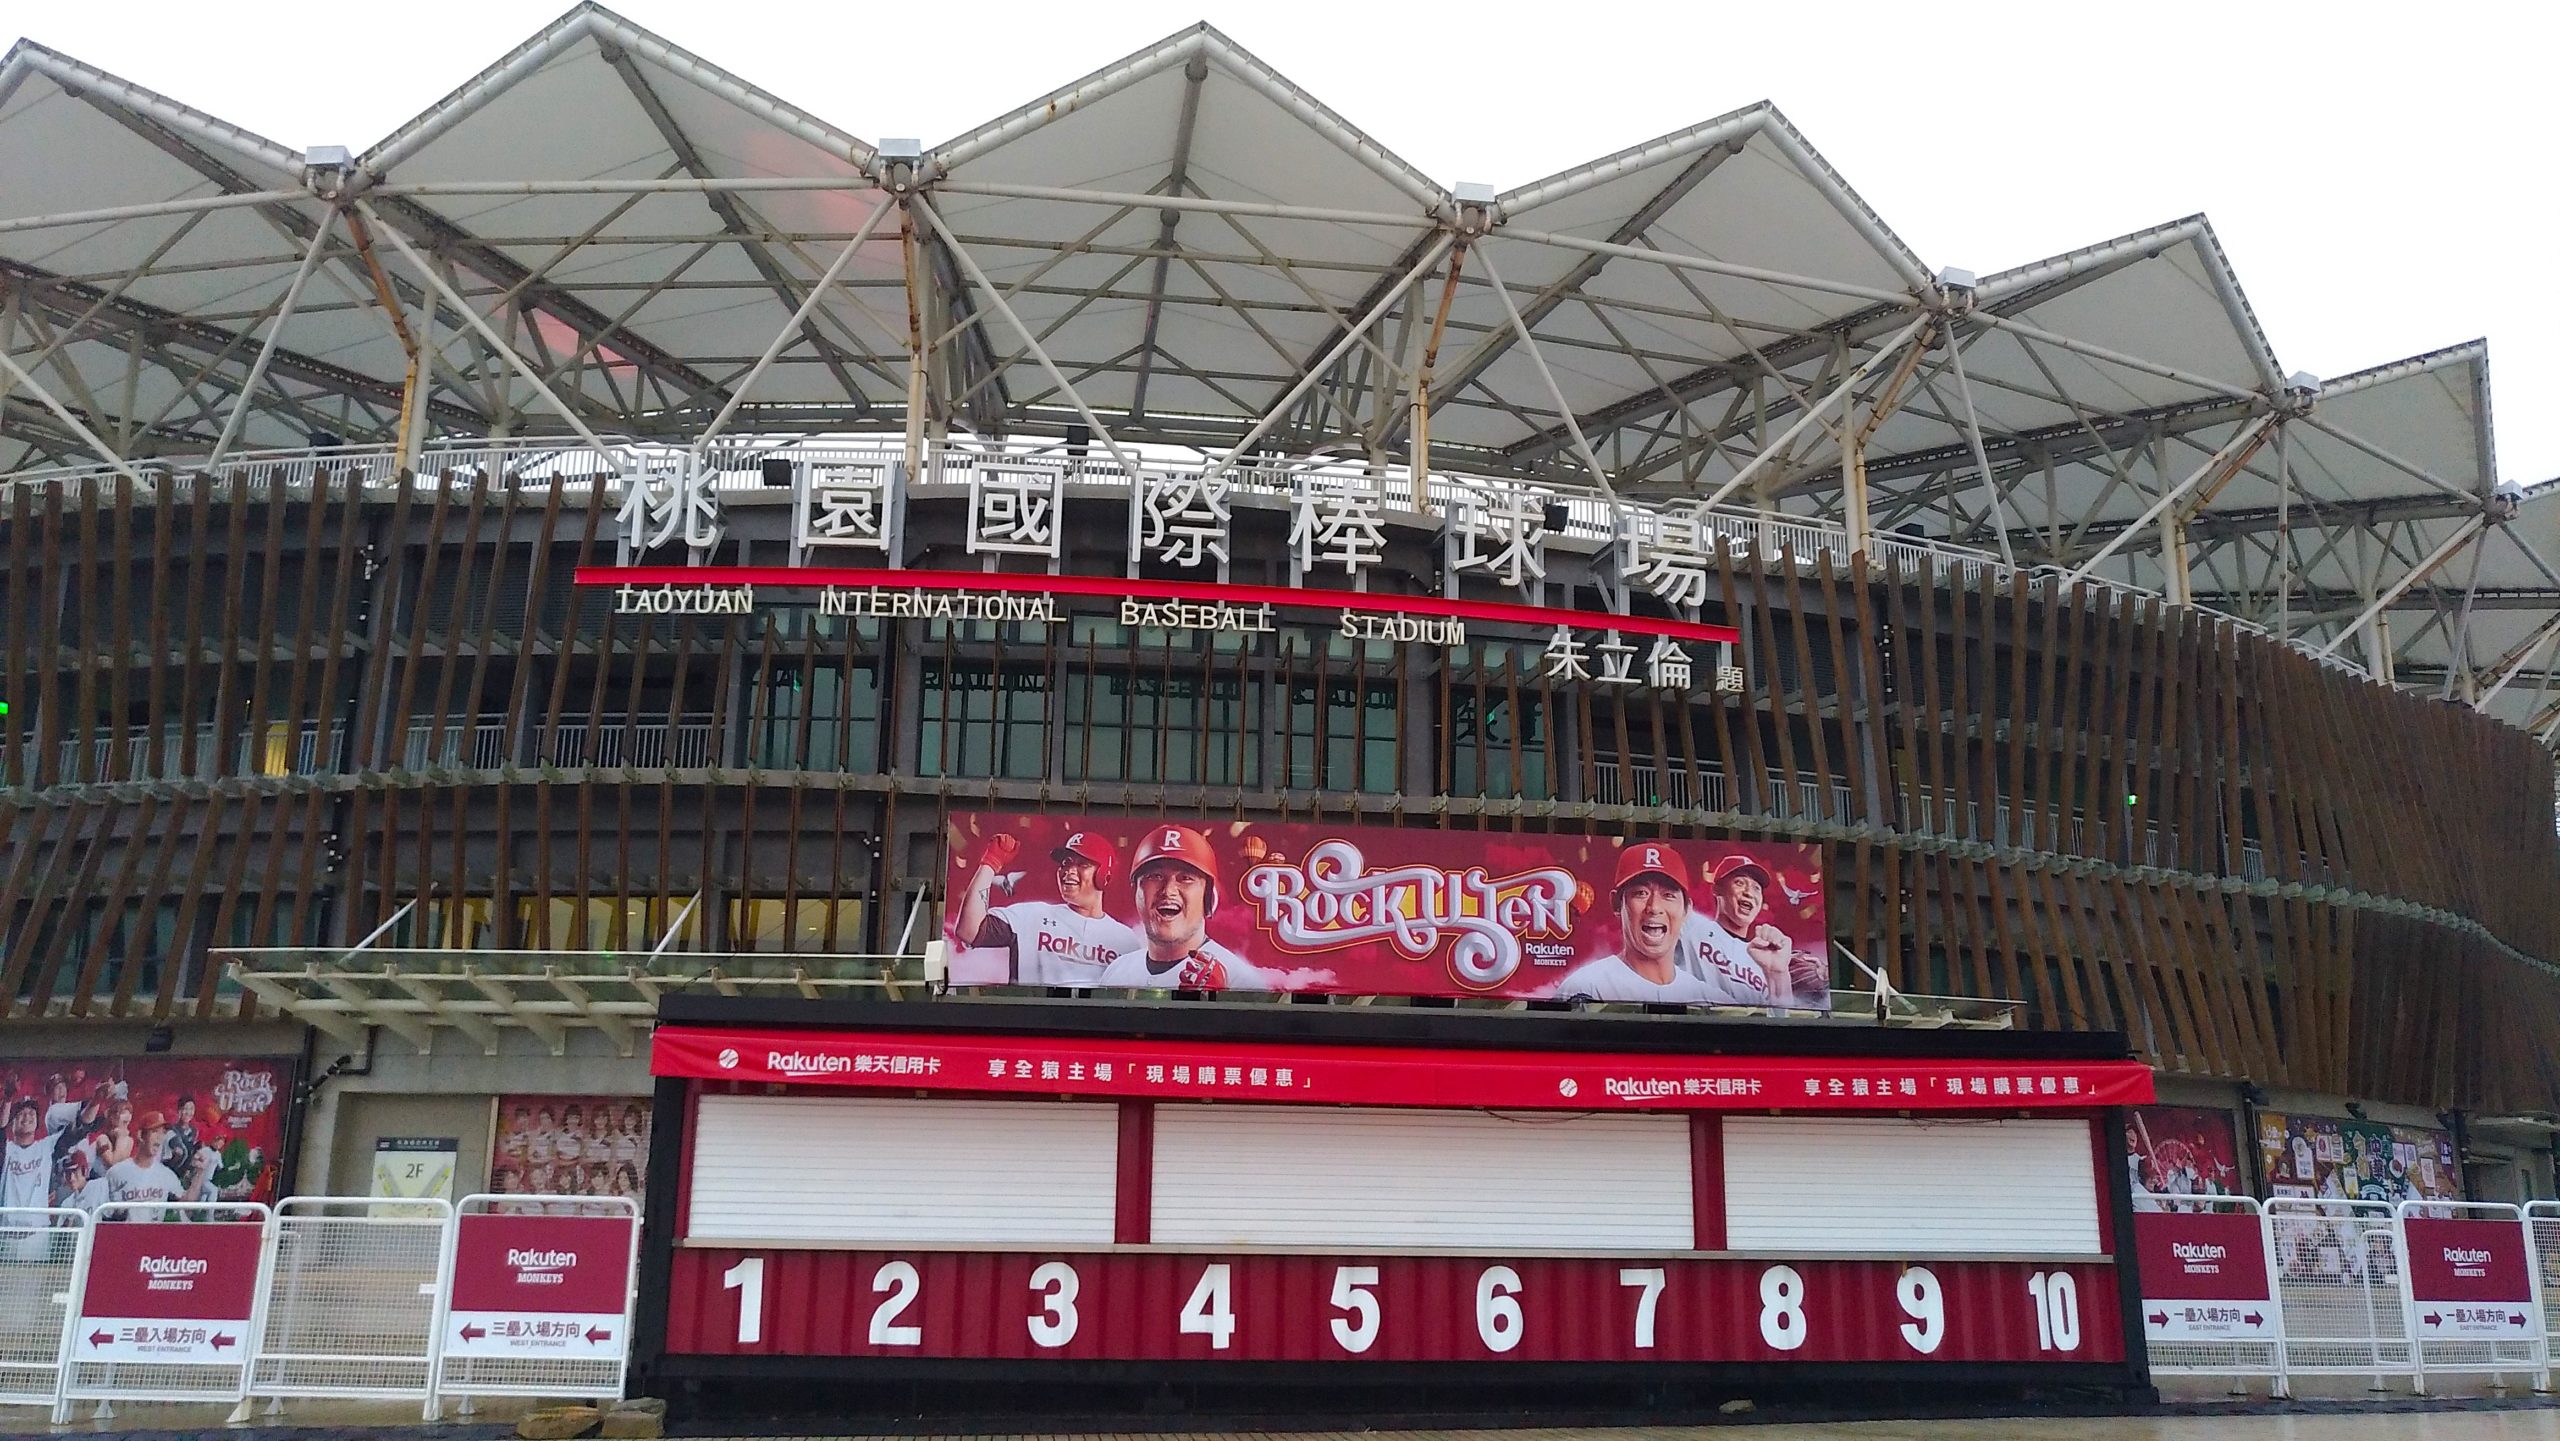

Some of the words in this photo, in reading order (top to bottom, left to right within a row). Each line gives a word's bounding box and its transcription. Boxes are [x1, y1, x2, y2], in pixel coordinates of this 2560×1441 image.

[615, 453, 1709, 608] 桃園國際棒球場
[615, 590, 753, 614] TAOYUAN
[819, 590, 1067, 623] INTERNATIONAL
[1120, 601, 1276, 634] BASEBALL
[1340, 614, 1465, 646] STADIUM
[1164, 830, 1182, 848] R
[1644, 848, 1662, 866] R
[1038, 932, 1122, 965] Rakute
[1525, 942, 1575, 957] Rakuten
[1533, 958, 1567, 967] MONKEYS
[1699, 941, 1768, 993] Raute
[768, 1051, 850, 1073] Rakuten
[855, 1055, 941, 1075] 樂天信用卡
[1605, 1077, 1681, 1096] Rakuten
[1684, 1078, 1762, 1096] 樂天信用卡
[405, 1163, 424, 1178] 2F
[508, 1248, 577, 1267] Rakuten
[2172, 1242, 2226, 1258] Rakuten
[2443, 1247, 2491, 1262] Rakuten
[139, 1255, 207, 1274] Rakuten
[517, 1273, 564, 1284] MONKEYS
[2184, 1265, 2219, 1273] MONKEYS
[148, 1280, 194, 1290] MONKEYS
[723, 1257, 764, 1343] 1
[868, 1261, 921, 1346] 2
[1027, 1262, 1080, 1348] 3
[1180, 1264, 1235, 1350] 4
[1330, 1266, 1380, 1353] 5
[1476, 1265, 1524, 1352] 6
[1619, 1268, 1666, 1348] 7
[1759, 1265, 1806, 1351] 8
[1896, 1266, 1945, 1354] 9
[2028, 1271, 2080, 1351] 10
